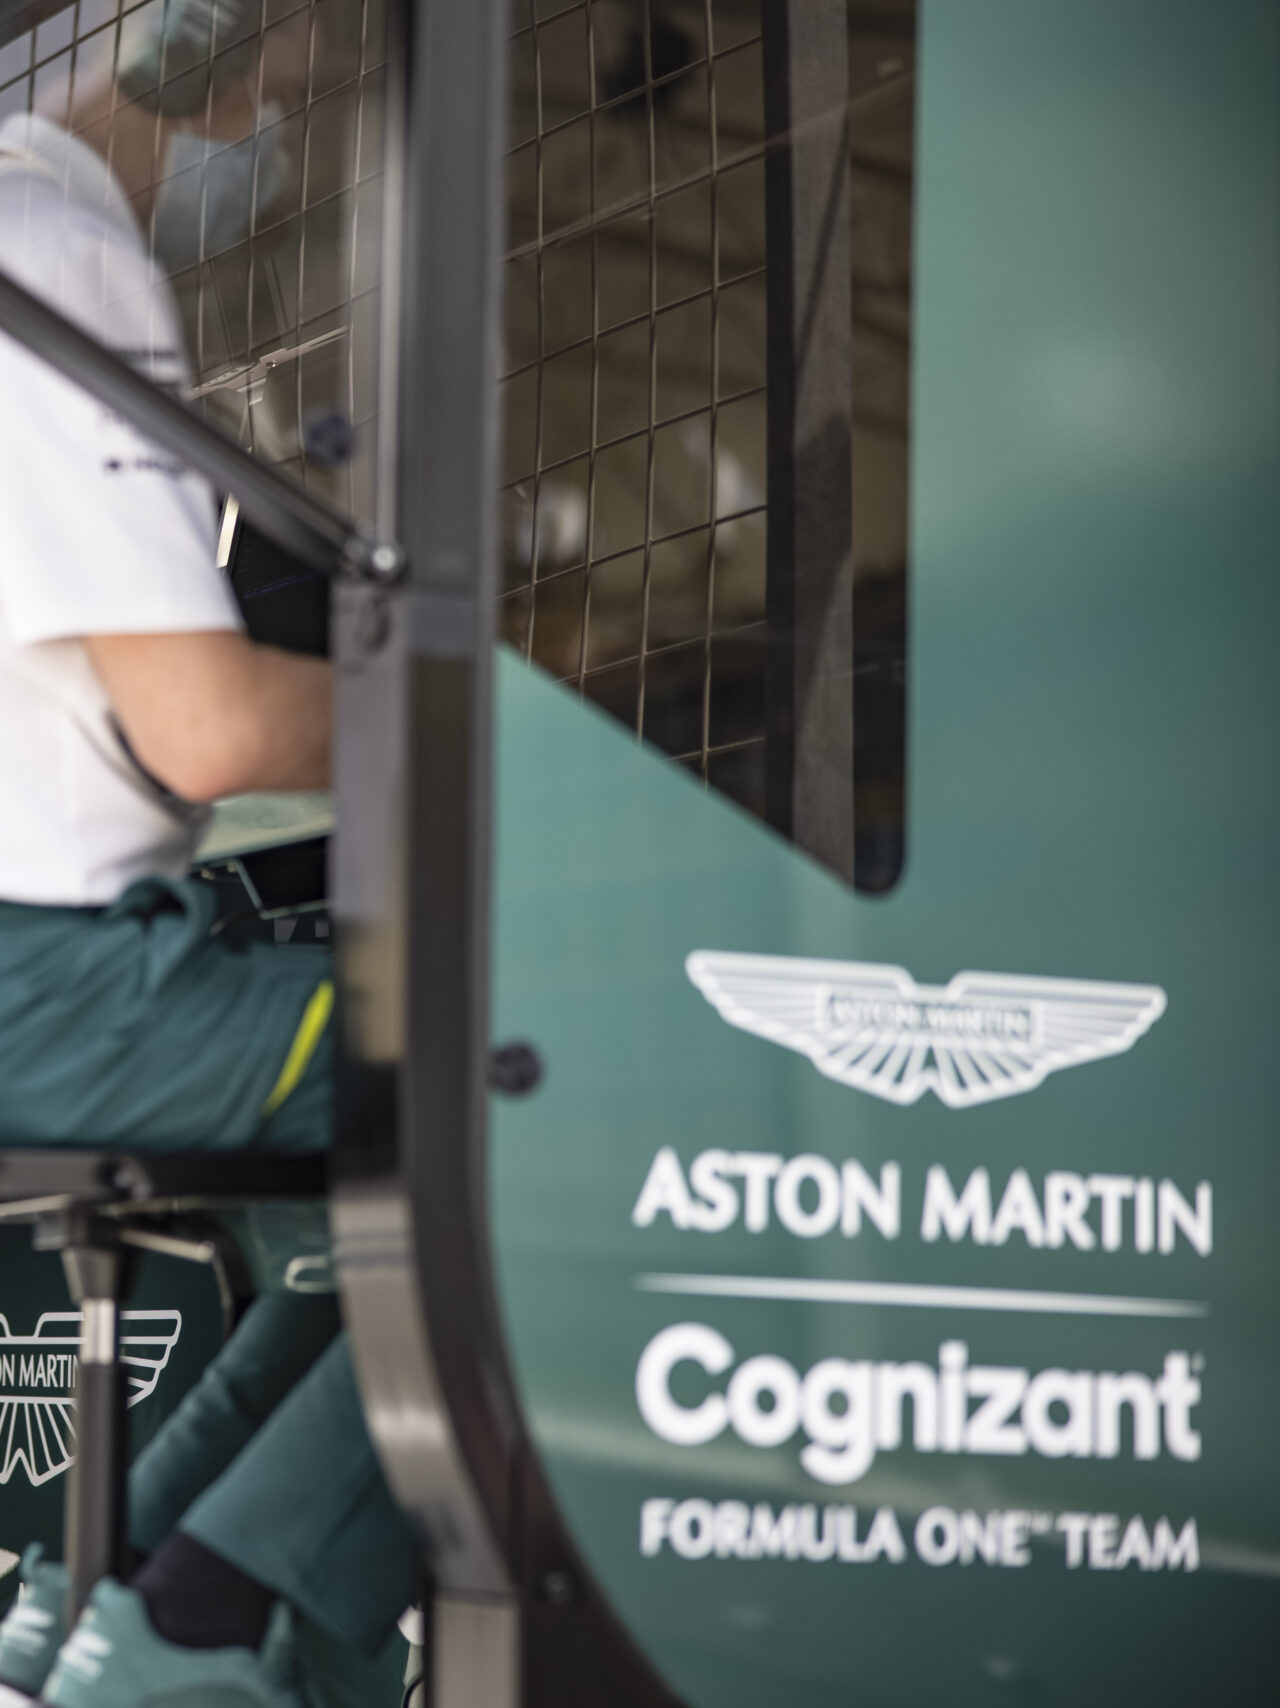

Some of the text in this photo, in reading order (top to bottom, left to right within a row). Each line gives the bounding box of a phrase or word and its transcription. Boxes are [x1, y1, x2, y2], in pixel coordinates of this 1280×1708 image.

[633, 1146, 1213, 1258] ASTON MARTIN
[635, 1322, 1203, 1485] Cognizant
[640, 1498, 907, 1565] FORMULA
[1056, 1511, 1200, 1572] TEAM
